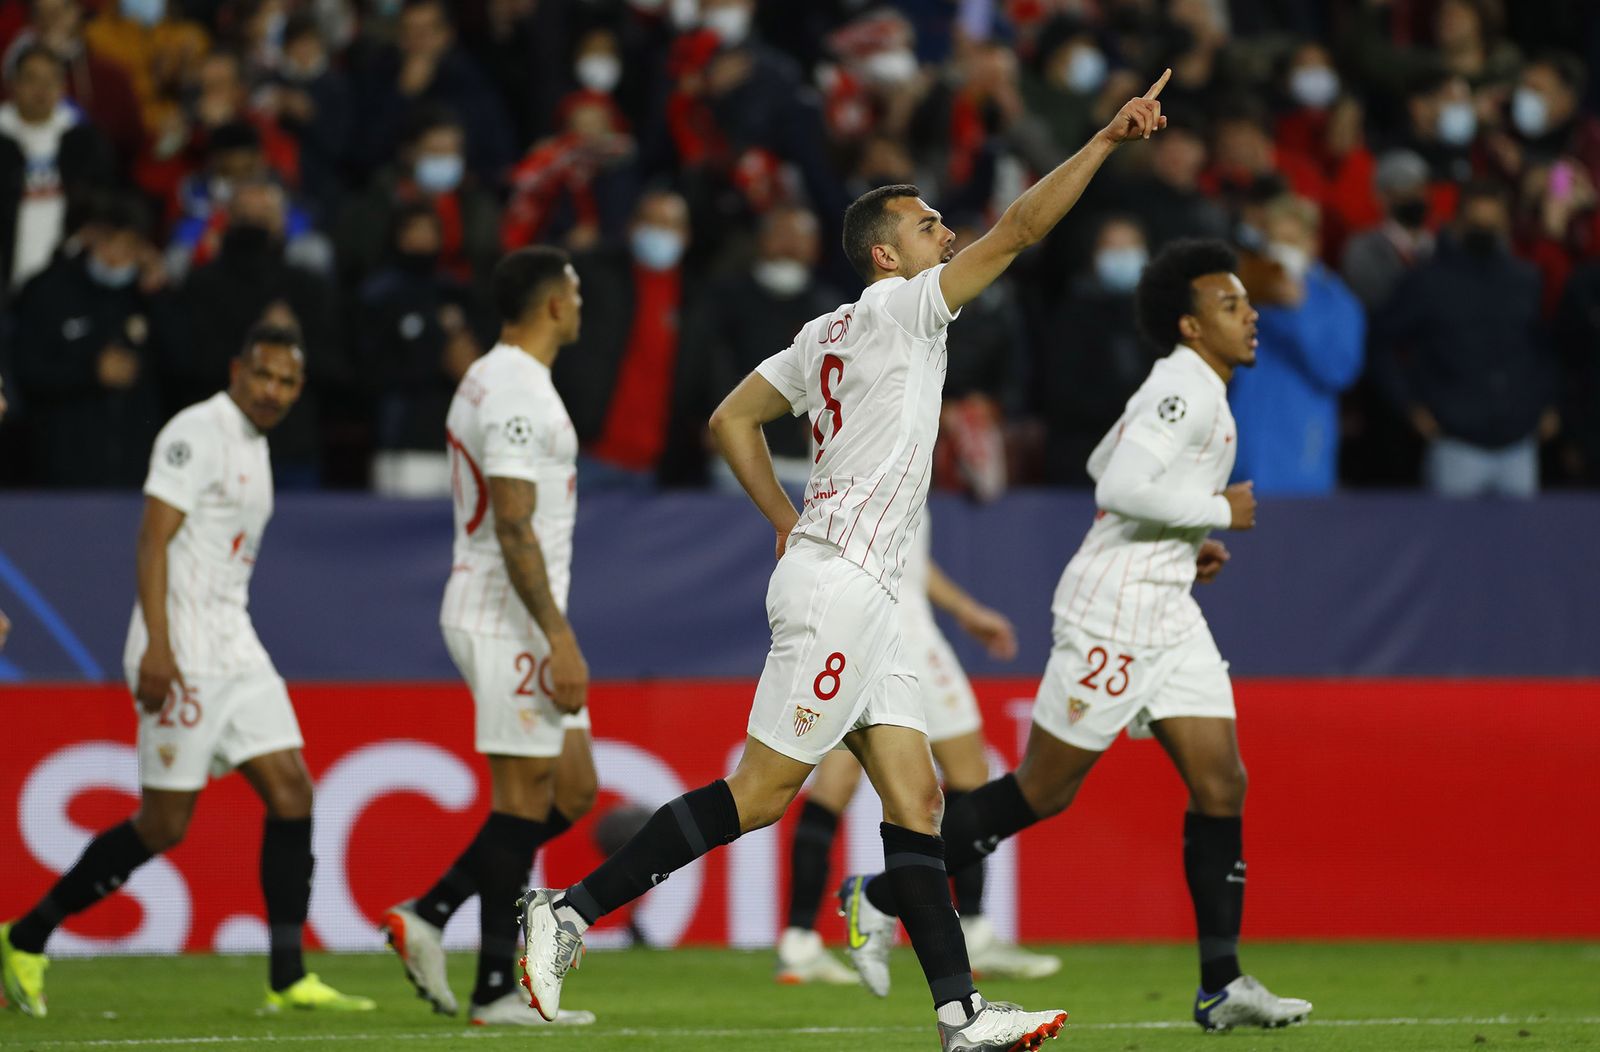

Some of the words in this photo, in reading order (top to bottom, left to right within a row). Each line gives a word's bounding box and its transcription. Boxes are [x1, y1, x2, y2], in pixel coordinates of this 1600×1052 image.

[813, 651, 846, 701] 8
[1078, 646, 1134, 697] 23
[157, 686, 203, 728] 25
